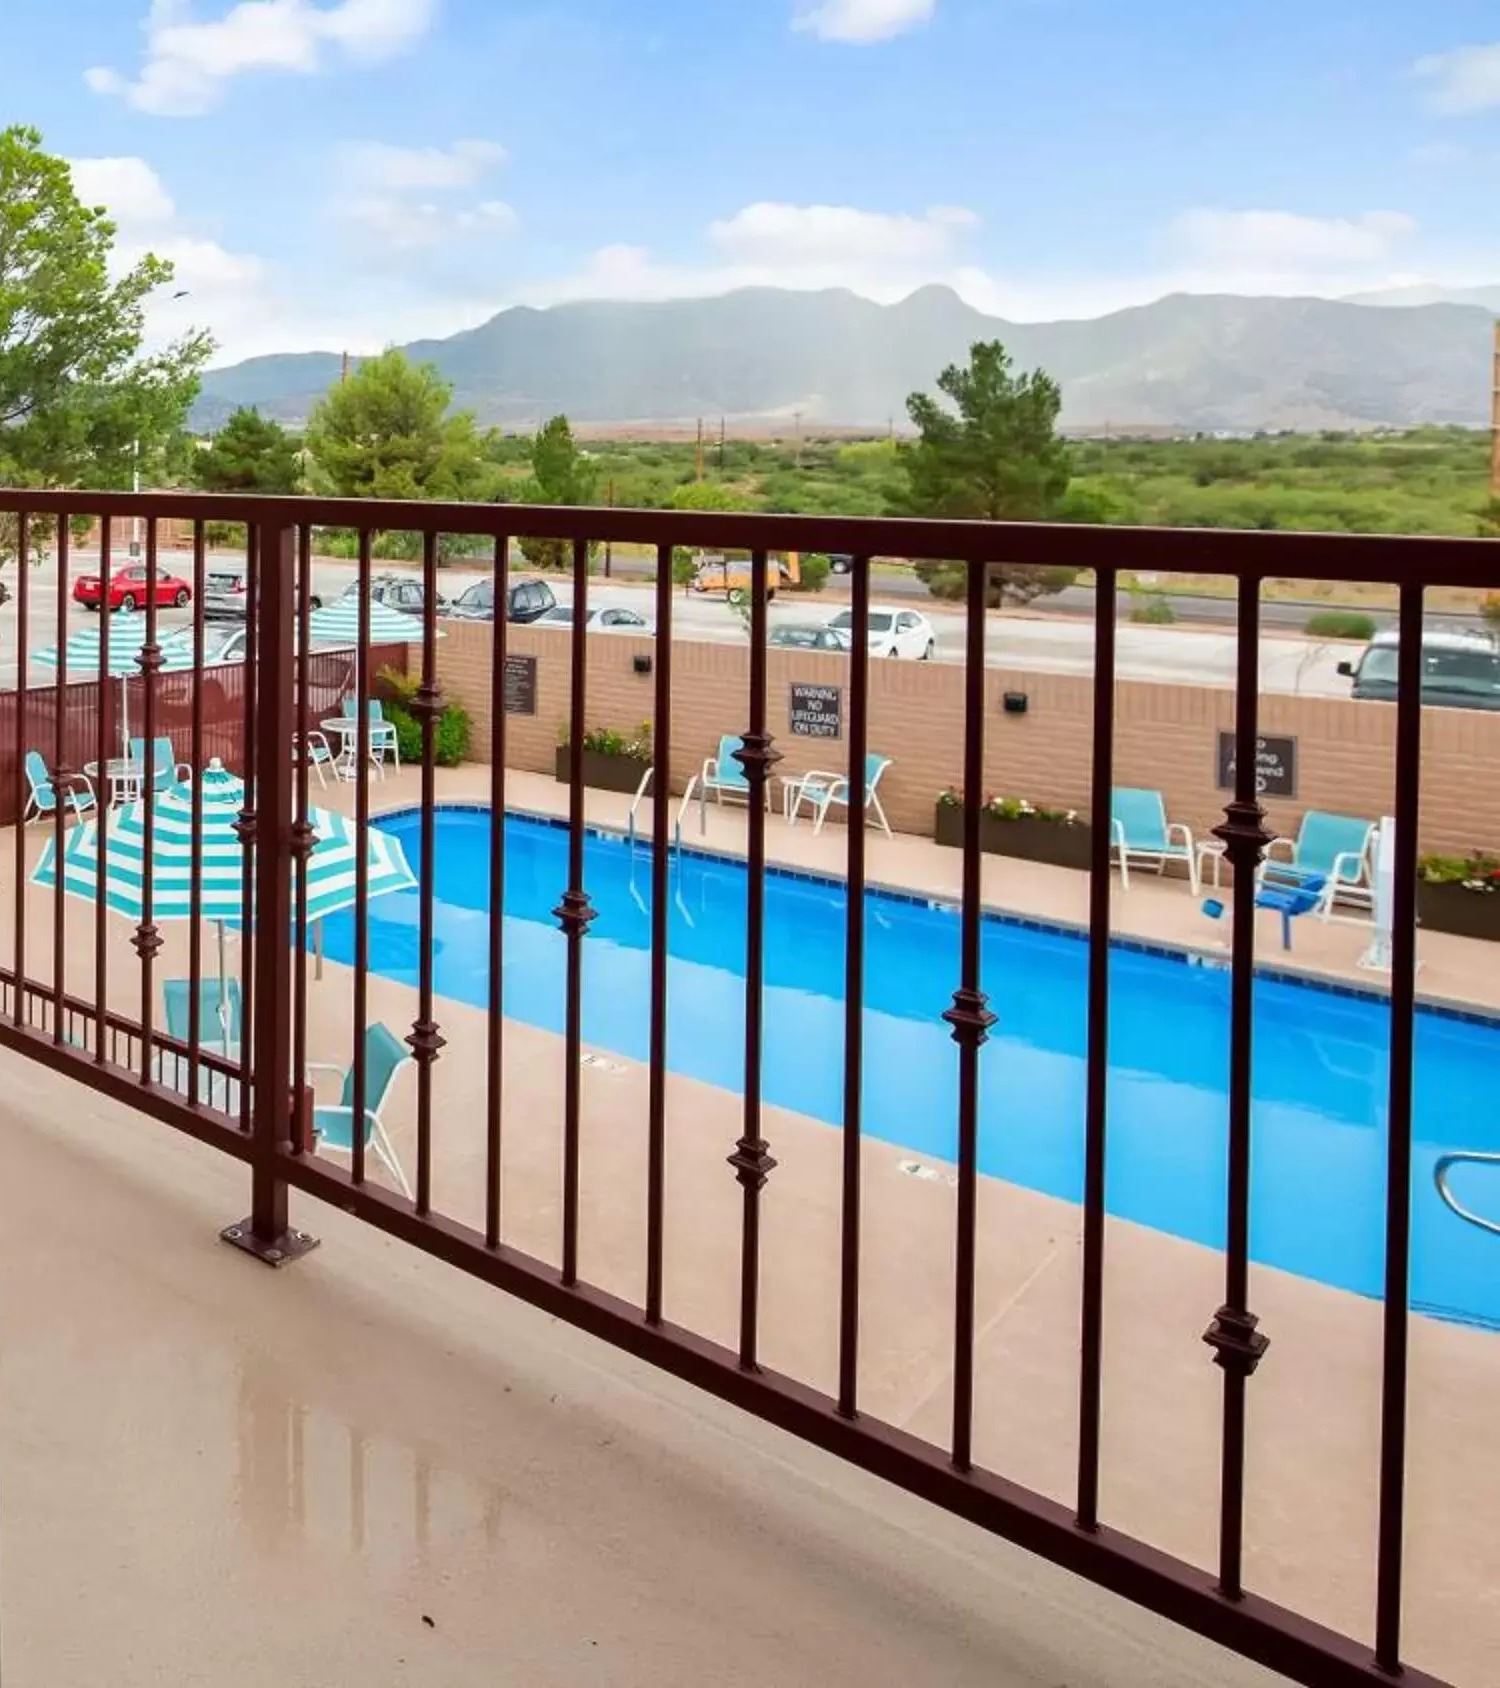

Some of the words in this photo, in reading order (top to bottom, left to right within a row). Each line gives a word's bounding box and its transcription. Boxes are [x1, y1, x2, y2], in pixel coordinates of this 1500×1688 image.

[794, 687, 837, 700] WARNING
[808, 700, 822, 710] NO
[792, 709, 839, 725] LIFEGUARD
[794, 722, 809, 733] ON
[810, 724, 835, 736] DUTY
